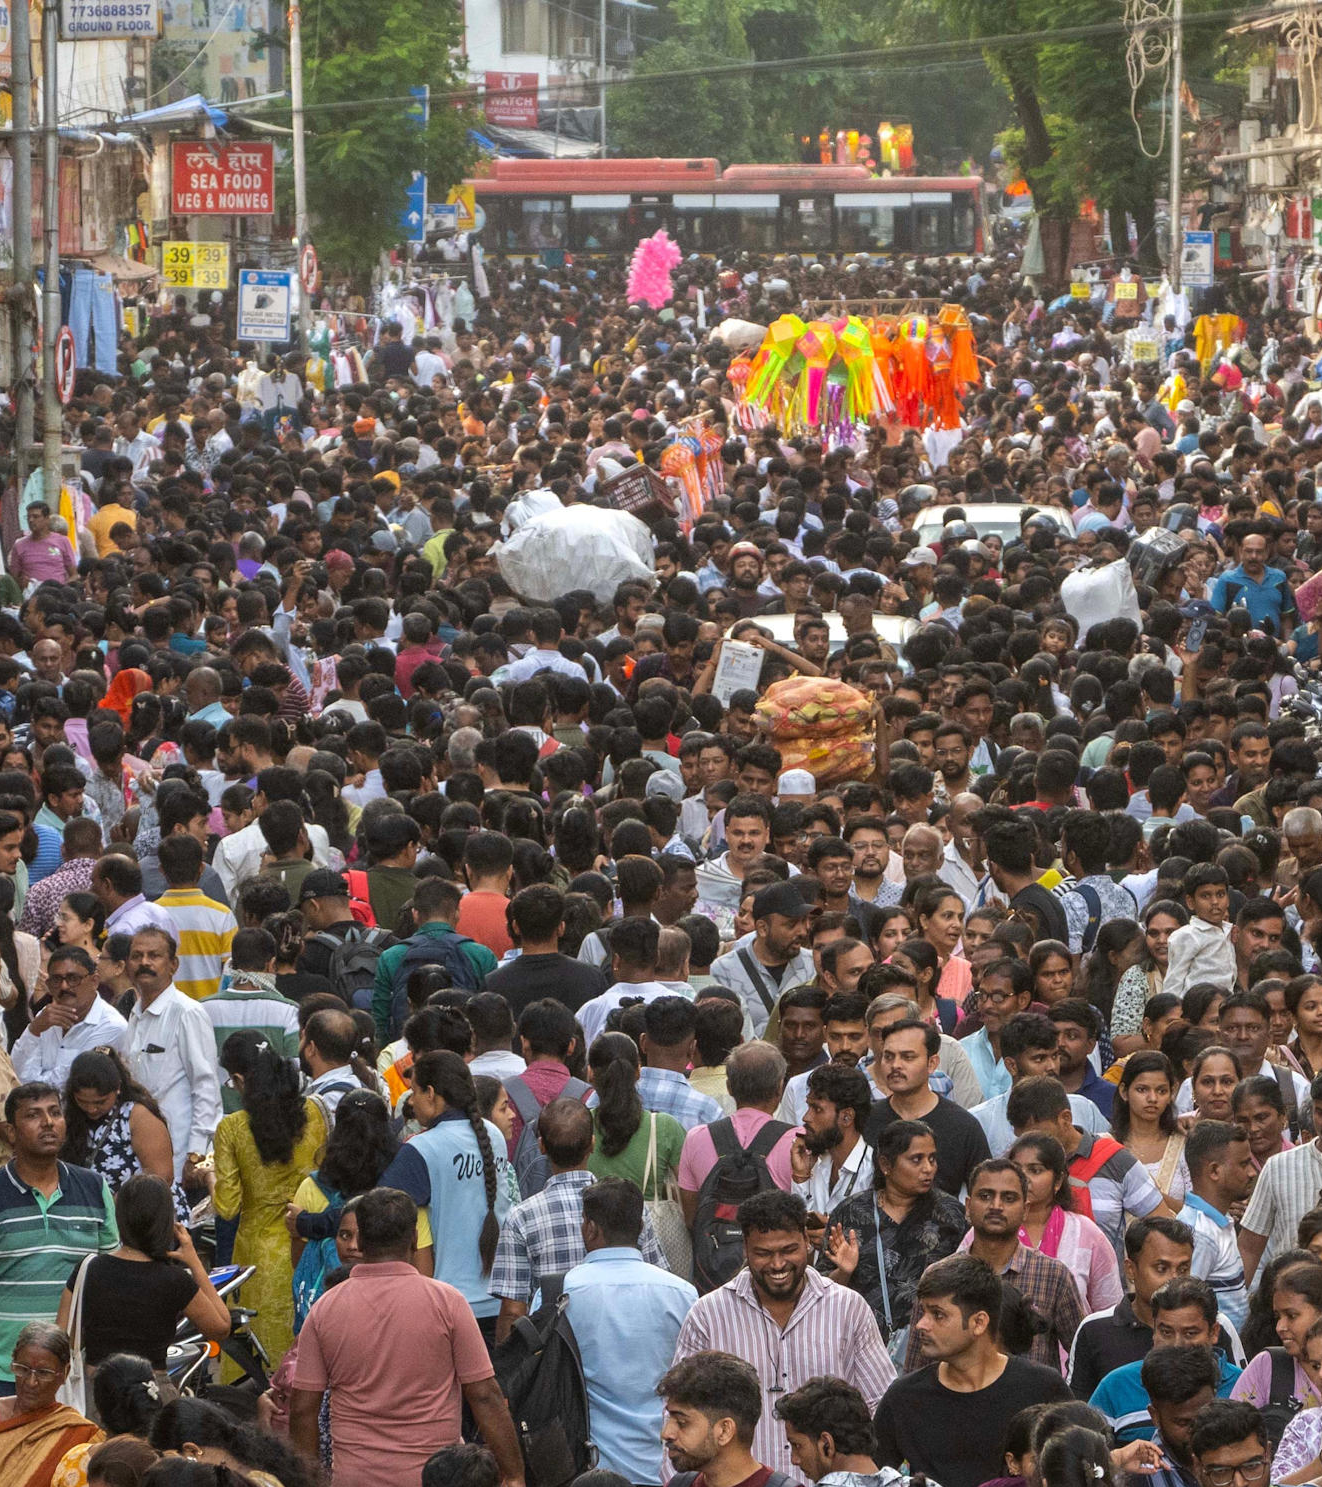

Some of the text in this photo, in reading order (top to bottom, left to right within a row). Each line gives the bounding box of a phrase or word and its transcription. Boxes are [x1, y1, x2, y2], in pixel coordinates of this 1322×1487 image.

[69, 20, 153, 32] GROUND FLOOR.
[491, 97, 533, 106] WATCH
[190, 173, 262, 189] SEA FOOD
[178, 193, 268, 209] VEG & NONVEG
